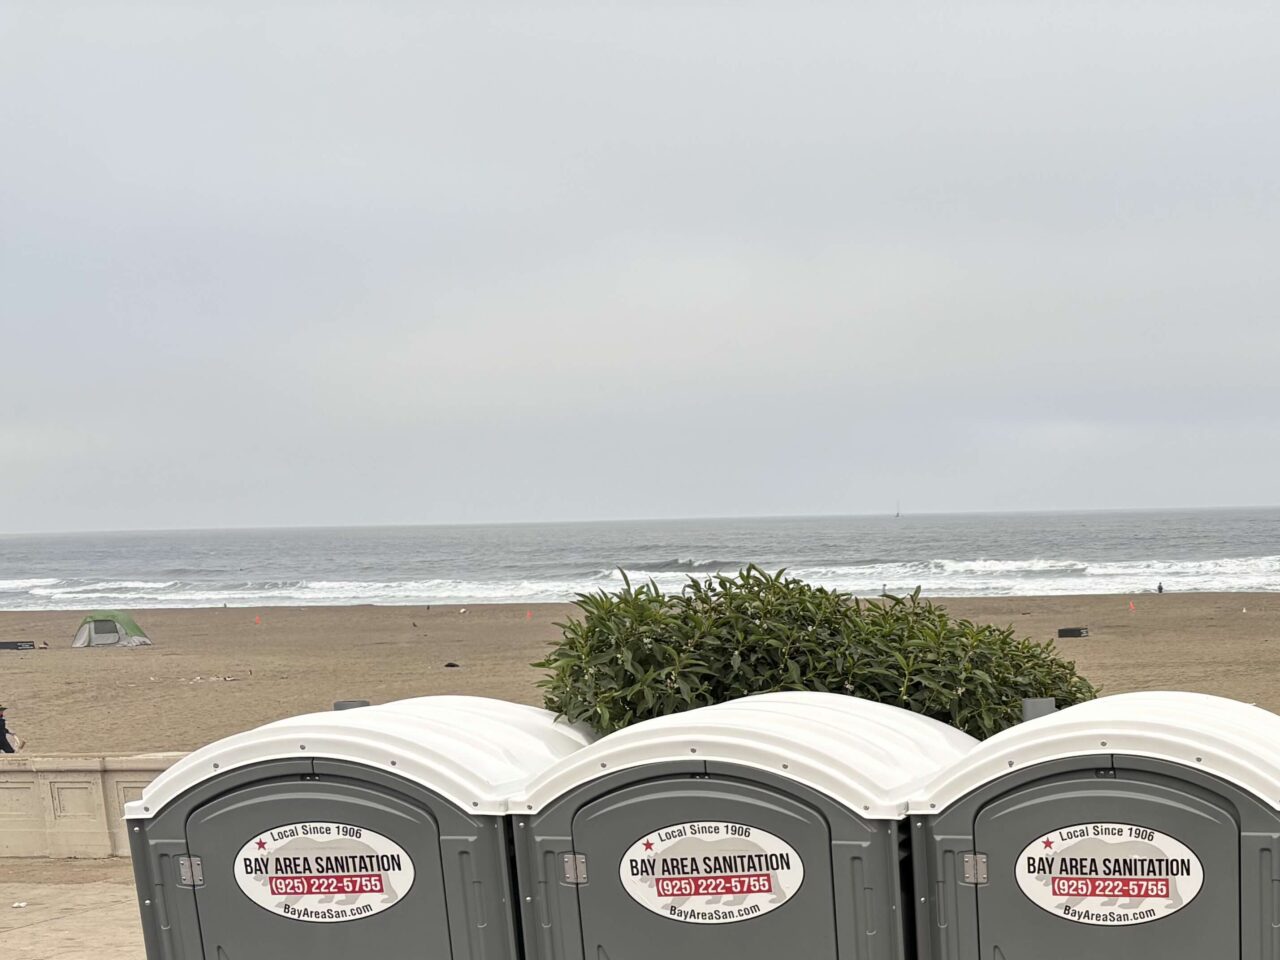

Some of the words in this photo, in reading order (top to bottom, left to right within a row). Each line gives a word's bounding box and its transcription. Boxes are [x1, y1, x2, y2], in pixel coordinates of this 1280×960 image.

[270, 826, 299, 842] Local
[302, 824, 331, 835] Since
[336, 825, 362, 839] 1906
[658, 827, 687, 842] Local
[690, 824, 720, 835] Since
[724, 824, 751, 838] 1906
[1059, 826, 1089, 841] Local
[1093, 825, 1123, 836] Since
[1128, 827, 1155, 842] 1906
[244, 857, 269, 874] BAY
[275, 857, 312, 874] AREA
[316, 854, 401, 874] SANITATION
[630, 859, 656, 876] BAY
[662, 857, 700, 876] AREA
[703, 853, 790, 874] SANITATION
[1027, 857, 1054, 874] BAY
[1059, 858, 1098, 876] AREA
[1103, 858, 1190, 876] SANITATION
[271, 879, 307, 894] (925)
[311, 877, 380, 893] 222-5755
[658, 880, 695, 895] (925)
[699, 876, 769, 893] 222-5755
[1054, 878, 1091, 895] (925)
[1096, 880, 1166, 896] 222-5755
[283, 903, 373, 919] BayAreaSan.com
[669, 904, 760, 921] BayAreaSan.com
[1063, 905, 1155, 922] BayAreaSan.com
